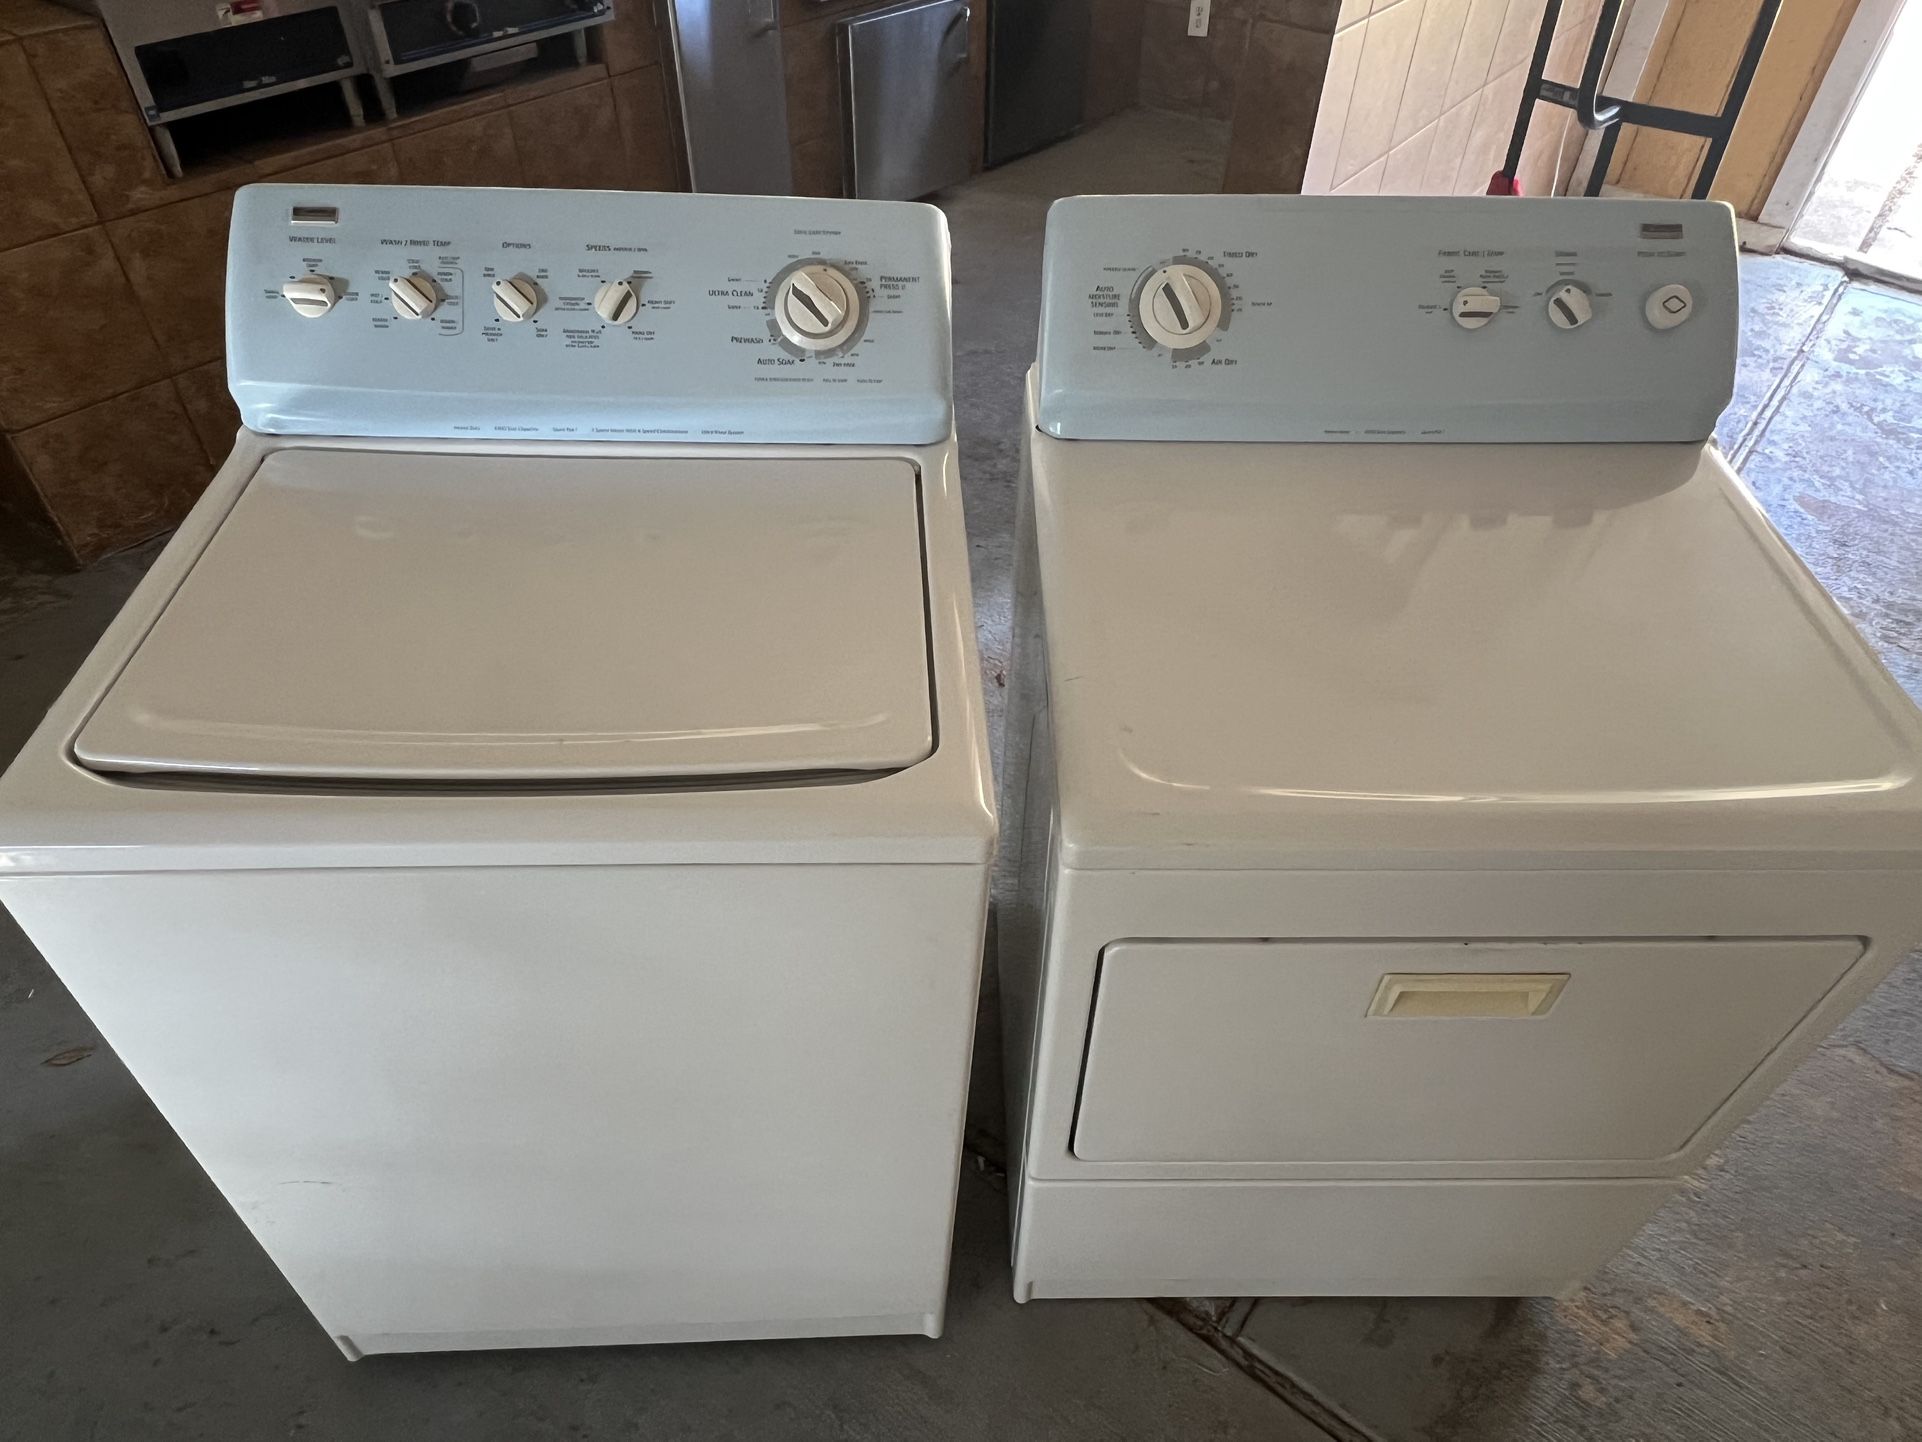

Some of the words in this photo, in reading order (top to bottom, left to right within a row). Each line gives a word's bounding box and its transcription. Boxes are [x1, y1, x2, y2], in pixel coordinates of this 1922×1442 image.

[502, 241, 531, 249] OPTIONS
[879, 275, 920, 284] PERMANENT
[708, 289, 730, 297] ULTRA
[731, 289, 754, 297] CLEAN
[757, 358, 775, 366] AUTO
[777, 358, 796, 366] SOAK
